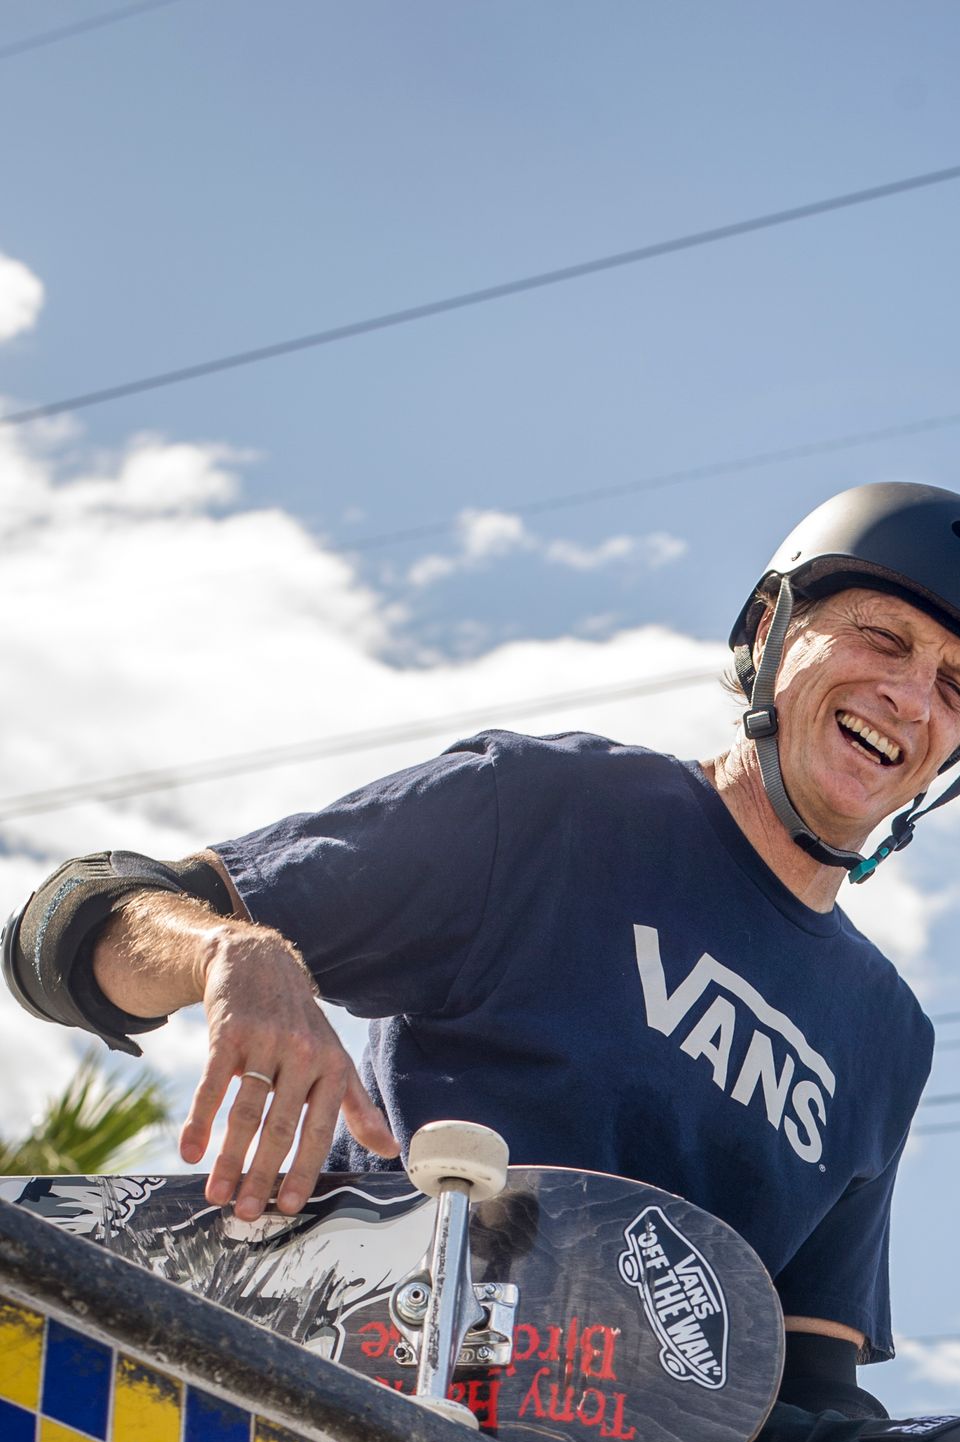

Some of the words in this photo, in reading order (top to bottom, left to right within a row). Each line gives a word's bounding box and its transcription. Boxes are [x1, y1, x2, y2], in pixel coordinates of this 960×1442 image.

[633, 923, 836, 1165] VANS
[652, 1269, 694, 1324] THE
[673, 1253, 721, 1320] VANS
[358, 1315, 622, 1381] Birde
[518, 1366, 637, 1440] Tony
